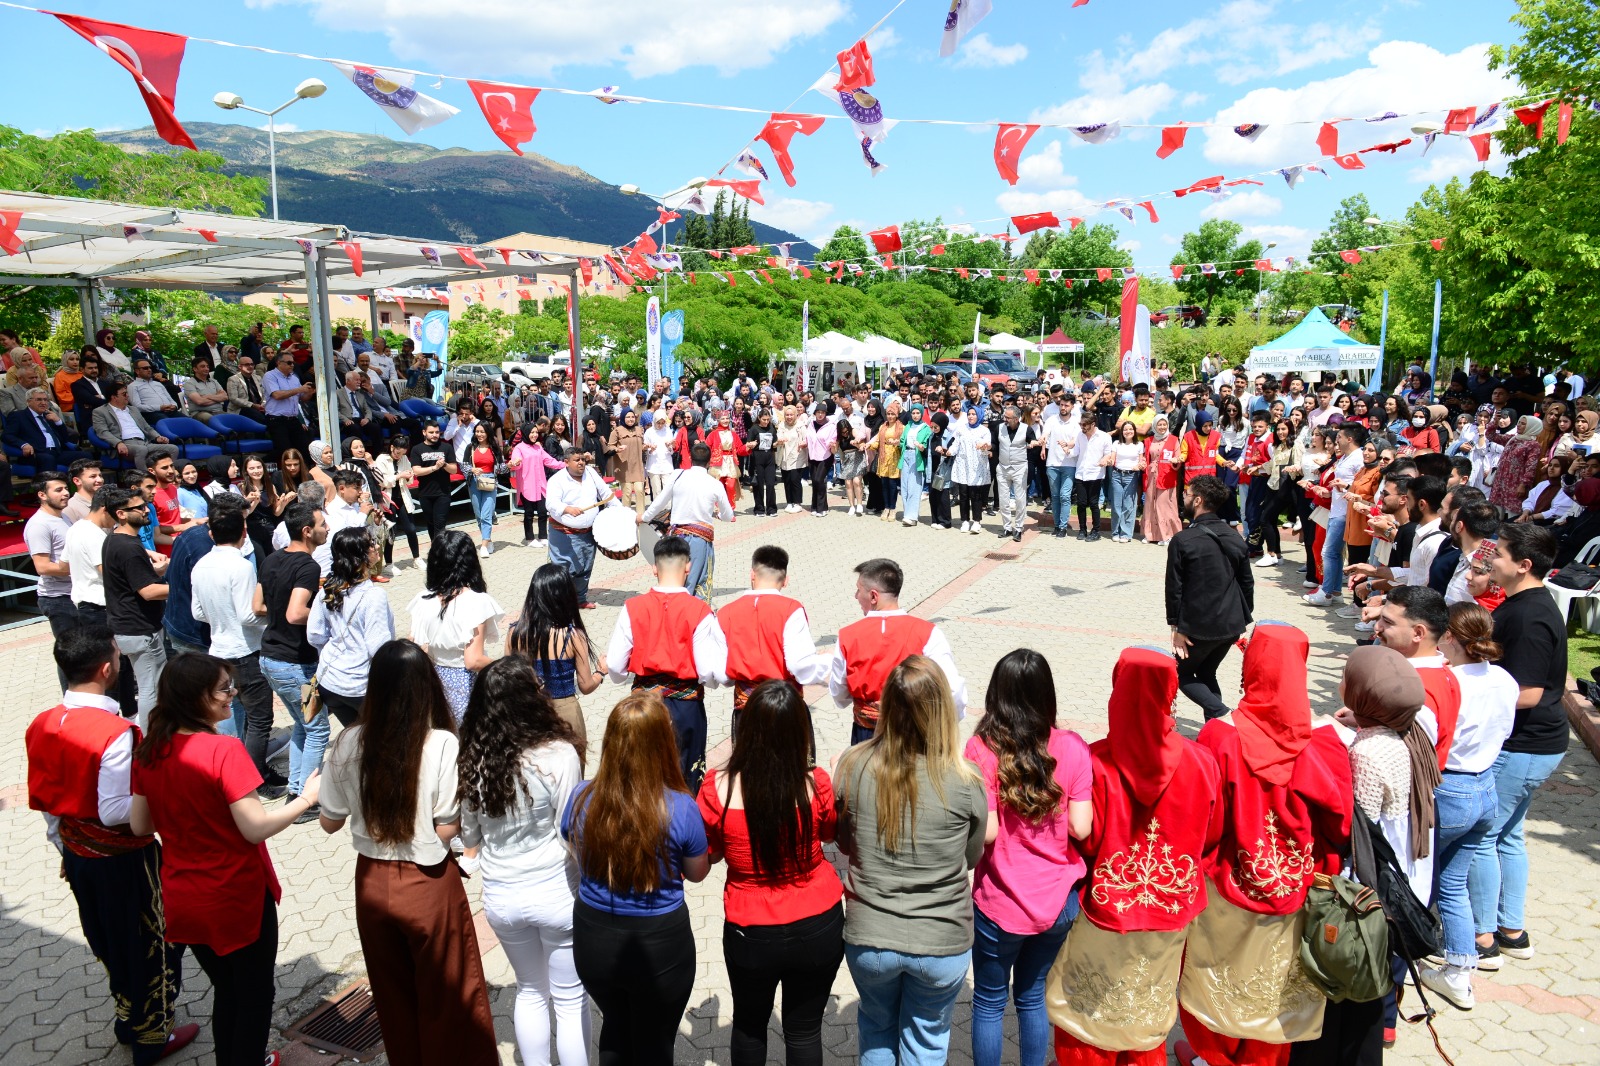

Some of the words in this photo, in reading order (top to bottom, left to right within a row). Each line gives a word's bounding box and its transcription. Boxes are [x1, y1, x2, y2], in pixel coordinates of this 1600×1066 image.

[1252, 355, 1289, 363] ARABICA
[1294, 353, 1332, 362] ARABICA
[1338, 352, 1376, 361] ARABICA
